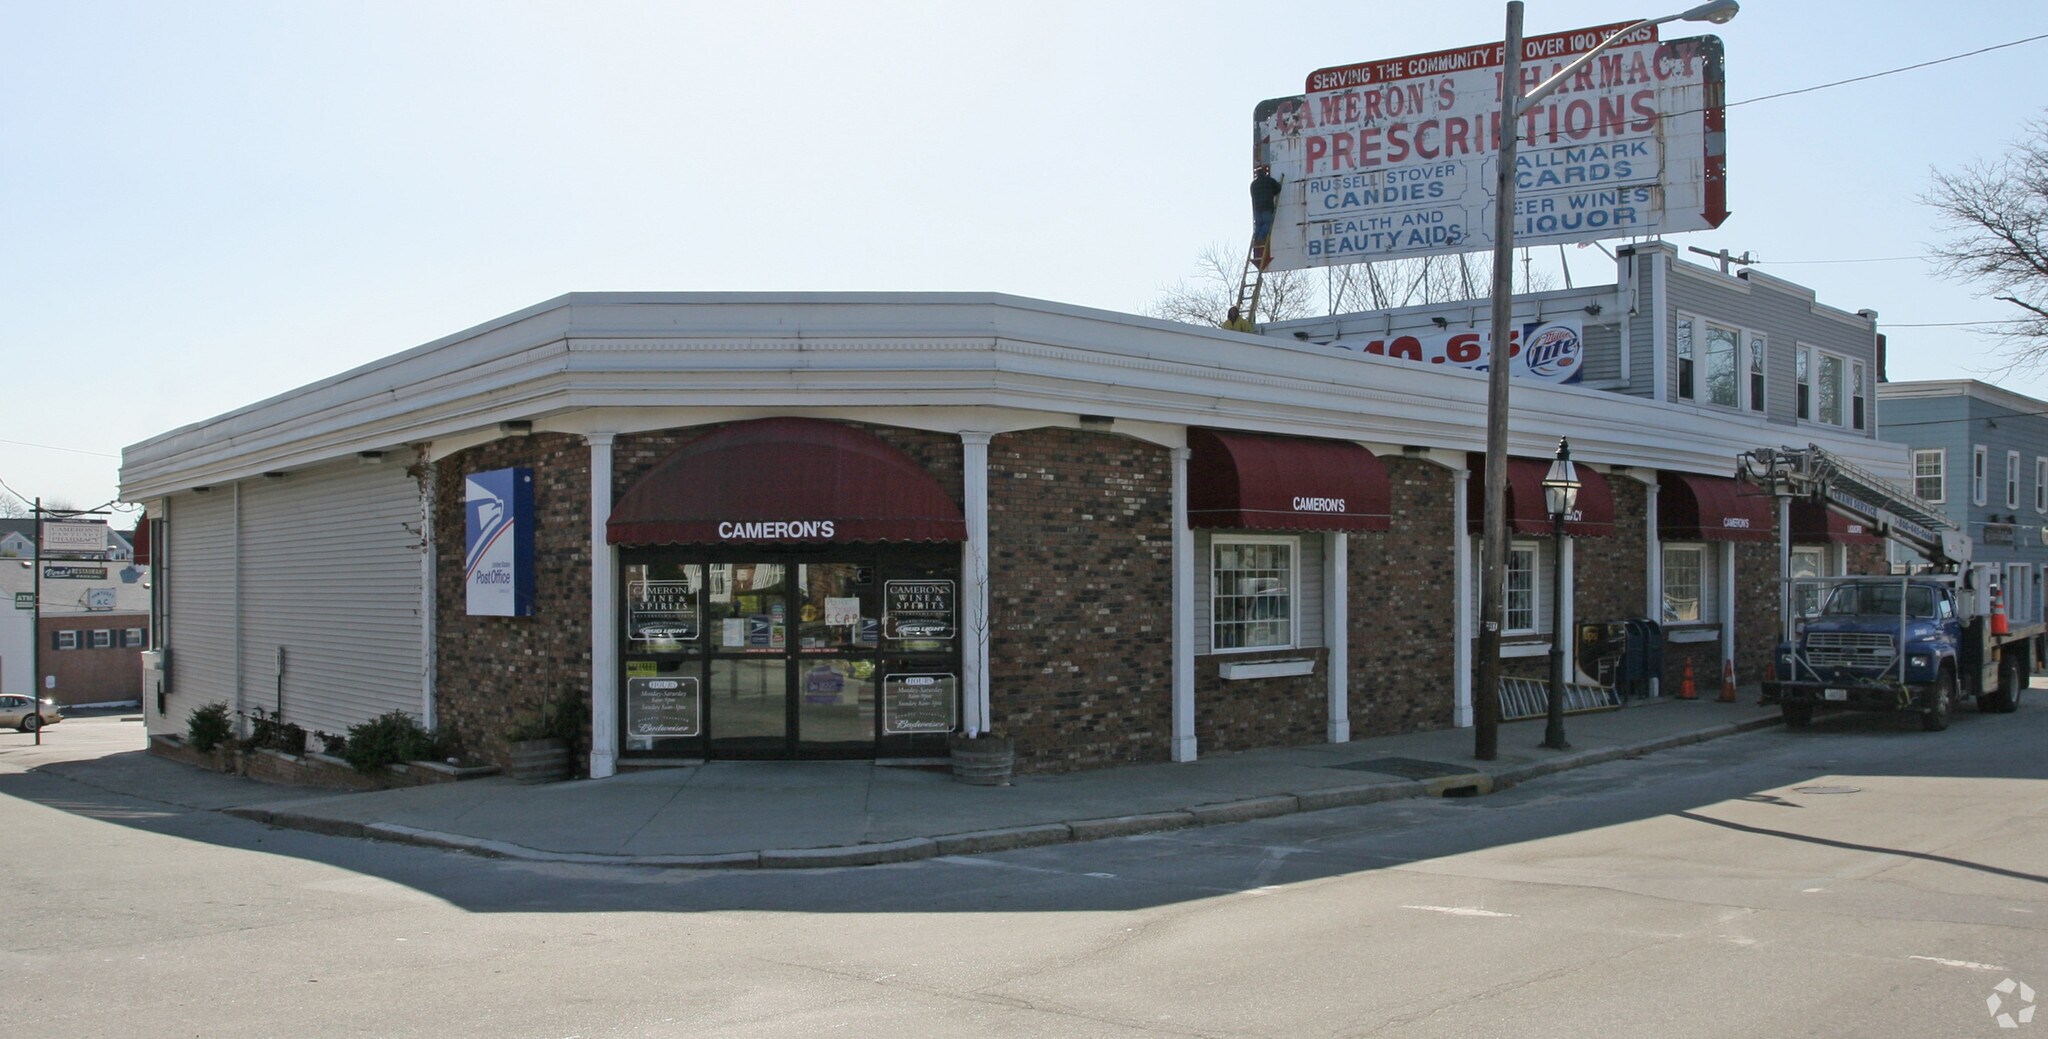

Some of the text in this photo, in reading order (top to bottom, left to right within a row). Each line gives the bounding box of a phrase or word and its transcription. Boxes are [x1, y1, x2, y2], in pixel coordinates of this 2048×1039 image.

[1526, 37, 1564, 58] OVER
[1569, 32, 1596, 51] 100
[1313, 67, 1371, 90] SERVING
[1376, 62, 1403, 79] THE
[1408, 48, 1490, 76] COMMUNITY
[1276, 78, 1455, 134] CAMERON'S
[1514, 141, 1648, 169] ALLMARK
[1310, 165, 1456, 193] RUSSELL STOVER
[1515, 161, 1632, 189] CARDS
[1324, 181, 1444, 210] CANDIES
[1514, 187, 1649, 216] EER WINES
[1322, 211, 1444, 236] HEALTH AND
[1308, 224, 1462, 256] BEAUTY AIDS
[1530, 338, 1578, 369] Lite
[1293, 496, 1345, 512] CAMERON'S
[718, 521, 835, 538] CAMERON'S
[476, 569, 511, 584] Post Office
[639, 602, 688, 610] SPIRITS
[896, 601, 944, 610] SPIRITS
[898, 594, 930, 602] WINE
[650, 681, 677, 689] HOURS
[907, 677, 933, 685] HOURS
[638, 723, 689, 733] Budweiser
[895, 720, 945, 729] Budweiser
